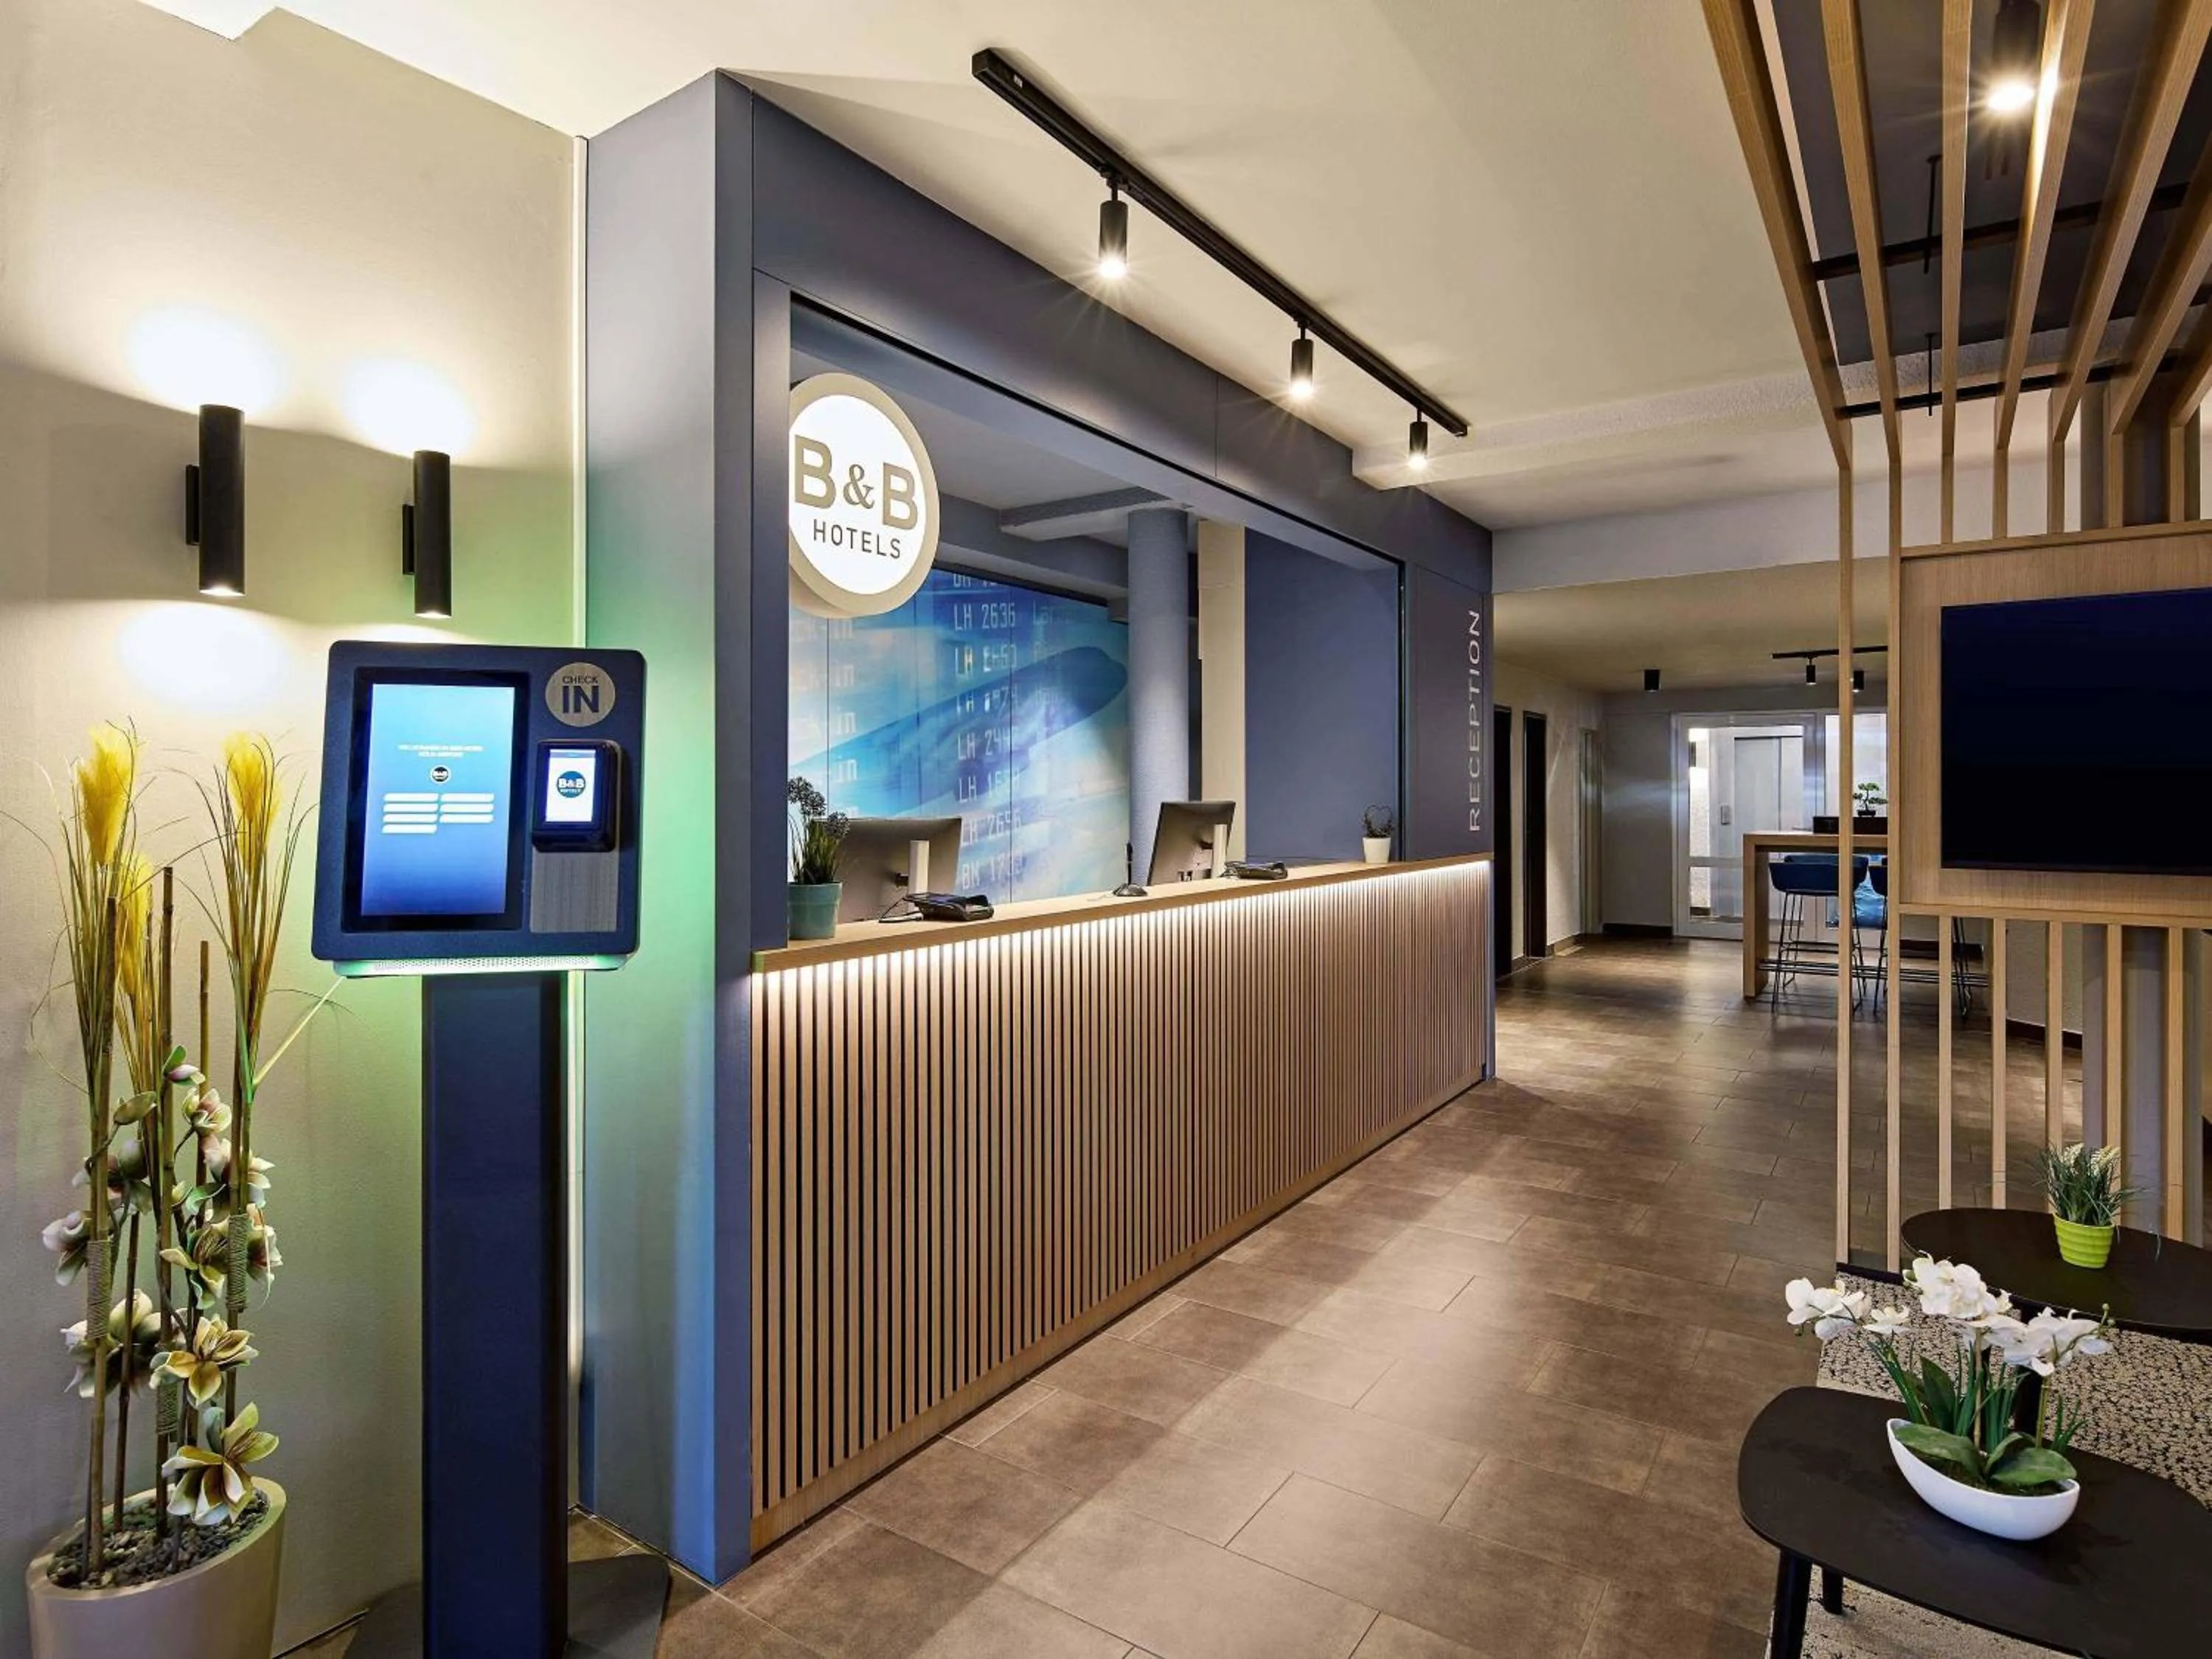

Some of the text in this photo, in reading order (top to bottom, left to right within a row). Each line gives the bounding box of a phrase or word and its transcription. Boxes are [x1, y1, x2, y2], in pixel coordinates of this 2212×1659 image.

[794, 434, 918, 530] B&B
[813, 518, 901, 559] HOTELS
[563, 674, 599, 685] CHECK
[563, 685, 599, 714] IN
[1469, 611, 1481, 831] RECEPTION
